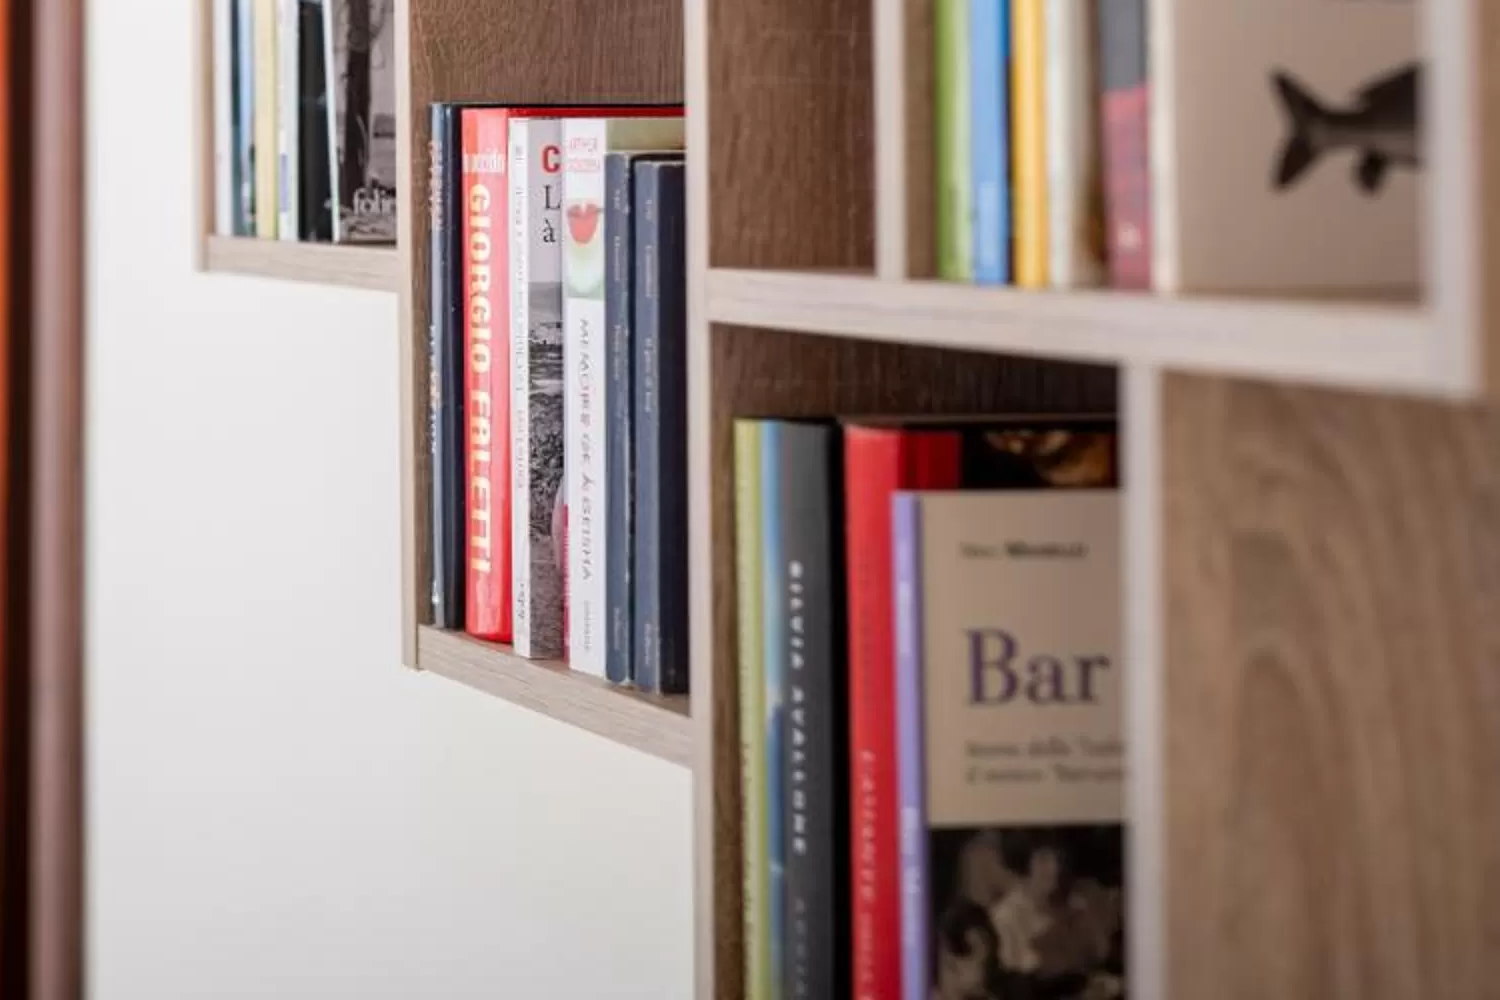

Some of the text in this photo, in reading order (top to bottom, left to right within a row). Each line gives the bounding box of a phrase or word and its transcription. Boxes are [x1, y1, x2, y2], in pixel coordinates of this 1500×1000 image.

[469, 183, 493, 374] GIORGIO
[542, 217, 556, 243] à
[469, 388, 493, 574] FALETTI
[962, 627, 1112, 706] Bar
